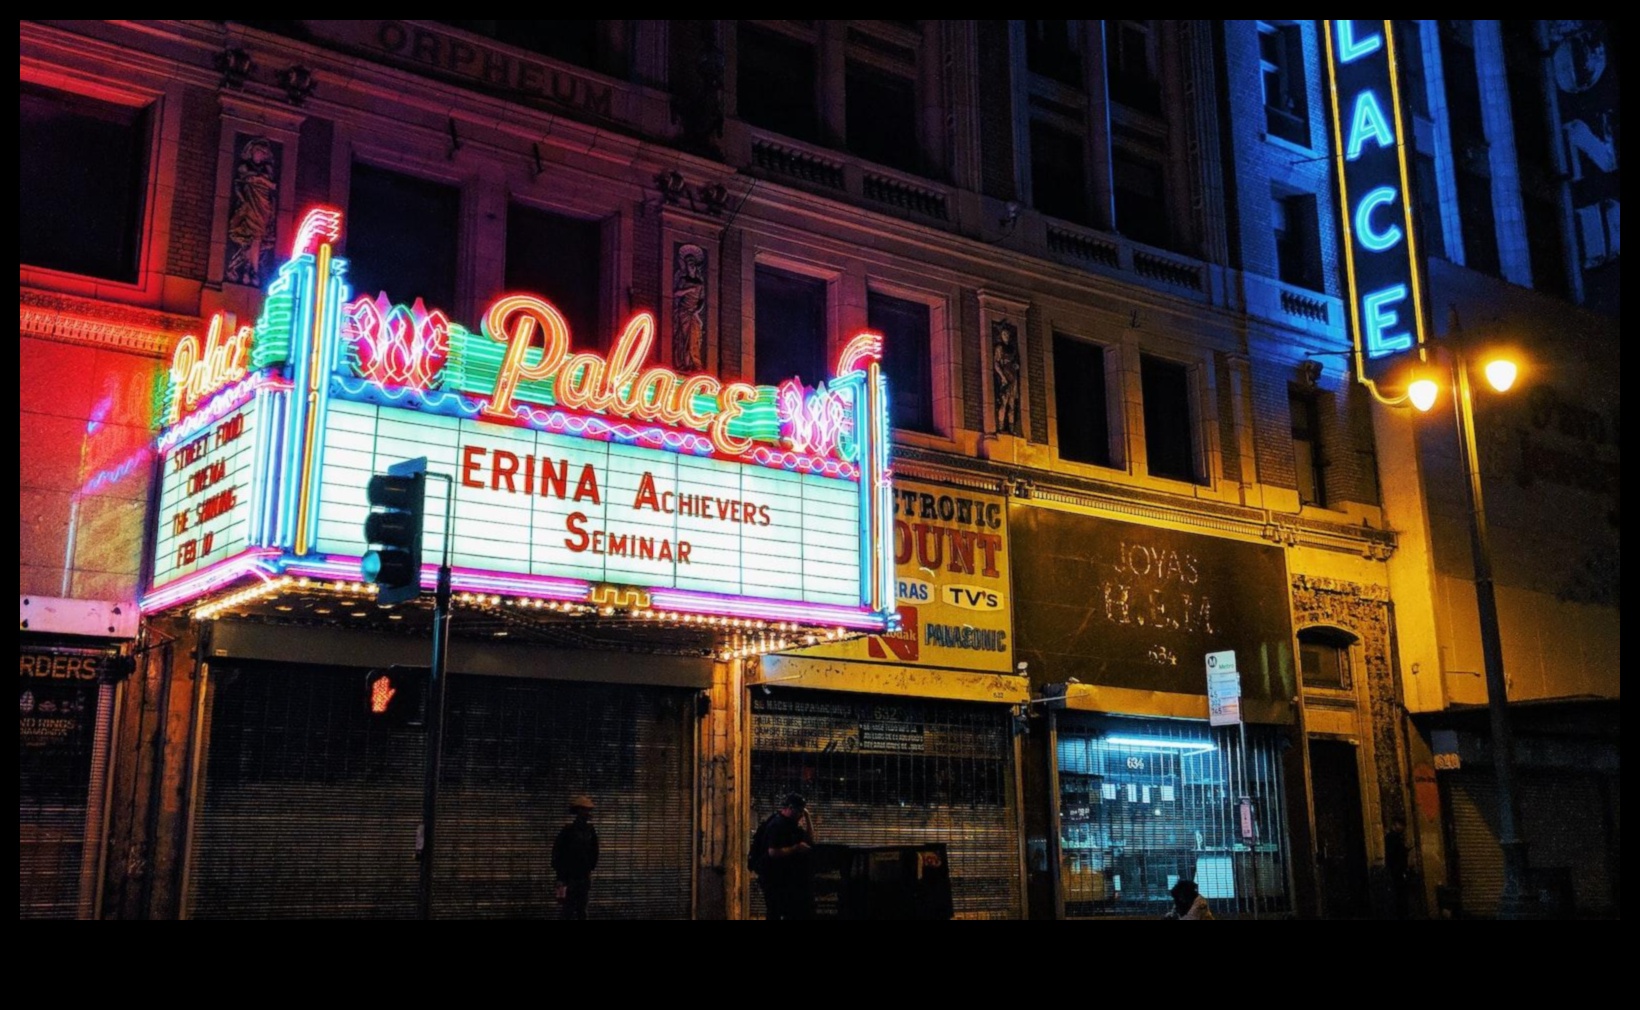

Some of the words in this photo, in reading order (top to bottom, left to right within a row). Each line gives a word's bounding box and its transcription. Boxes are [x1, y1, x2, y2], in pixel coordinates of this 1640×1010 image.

[379, 22, 613, 112] ORPHEUM
[169, 313, 254, 424] Palace
[480, 295, 757, 454] Palace
[173, 432, 211, 473] STREET
[215, 413, 243, 450] FOOD
[462, 445, 601, 506] ERINA
[173, 508, 190, 537] THE
[1114, 541, 1199, 584] JOYAS
[20, 655, 97, 680] RDERS
[925, 623, 1006, 652] PANASONIC
